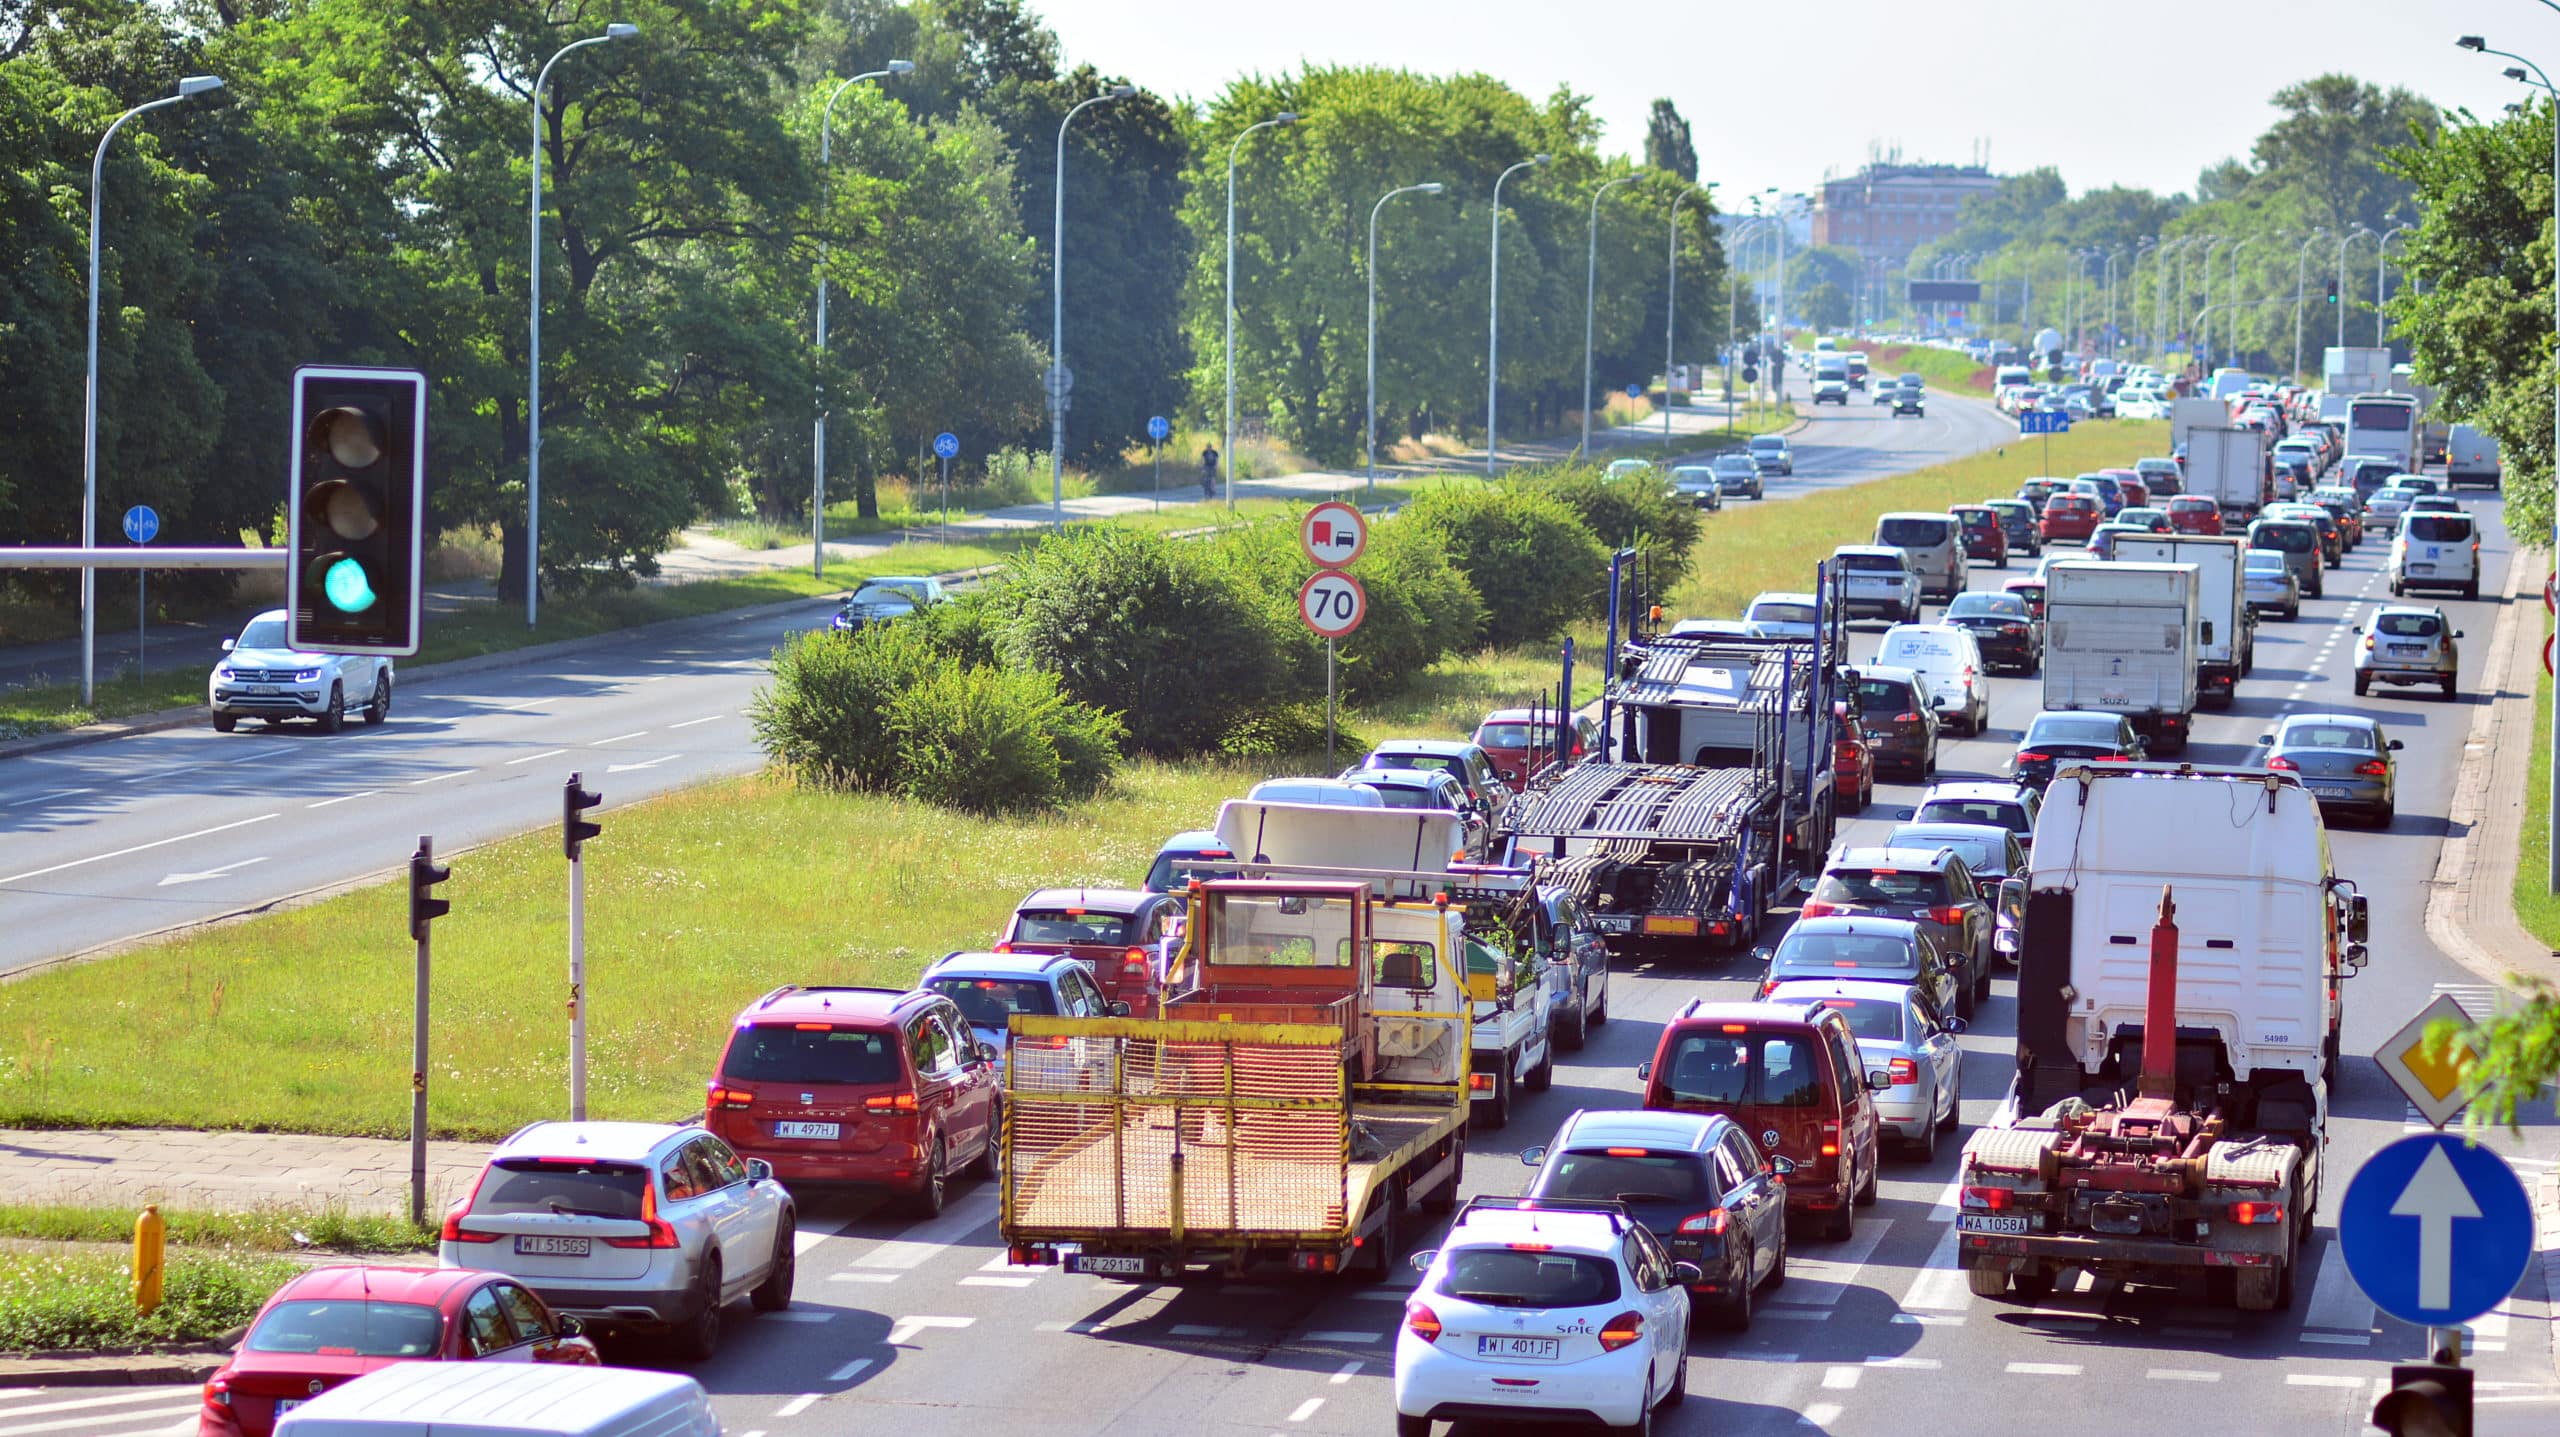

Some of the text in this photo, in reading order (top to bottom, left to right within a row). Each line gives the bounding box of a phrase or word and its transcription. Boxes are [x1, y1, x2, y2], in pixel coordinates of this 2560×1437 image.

[1314, 589, 1353, 620] 70
[2100, 697, 2129, 706] ISUZU
[782, 1122, 835, 1136] WI 497HJ
[1966, 1217, 2025, 1232] WA 1058A
[523, 1237, 587, 1253] WI 515GS
[1081, 1258, 1140, 1272] WZ 2913W
[1489, 1339, 1554, 1355] WI 401JF
